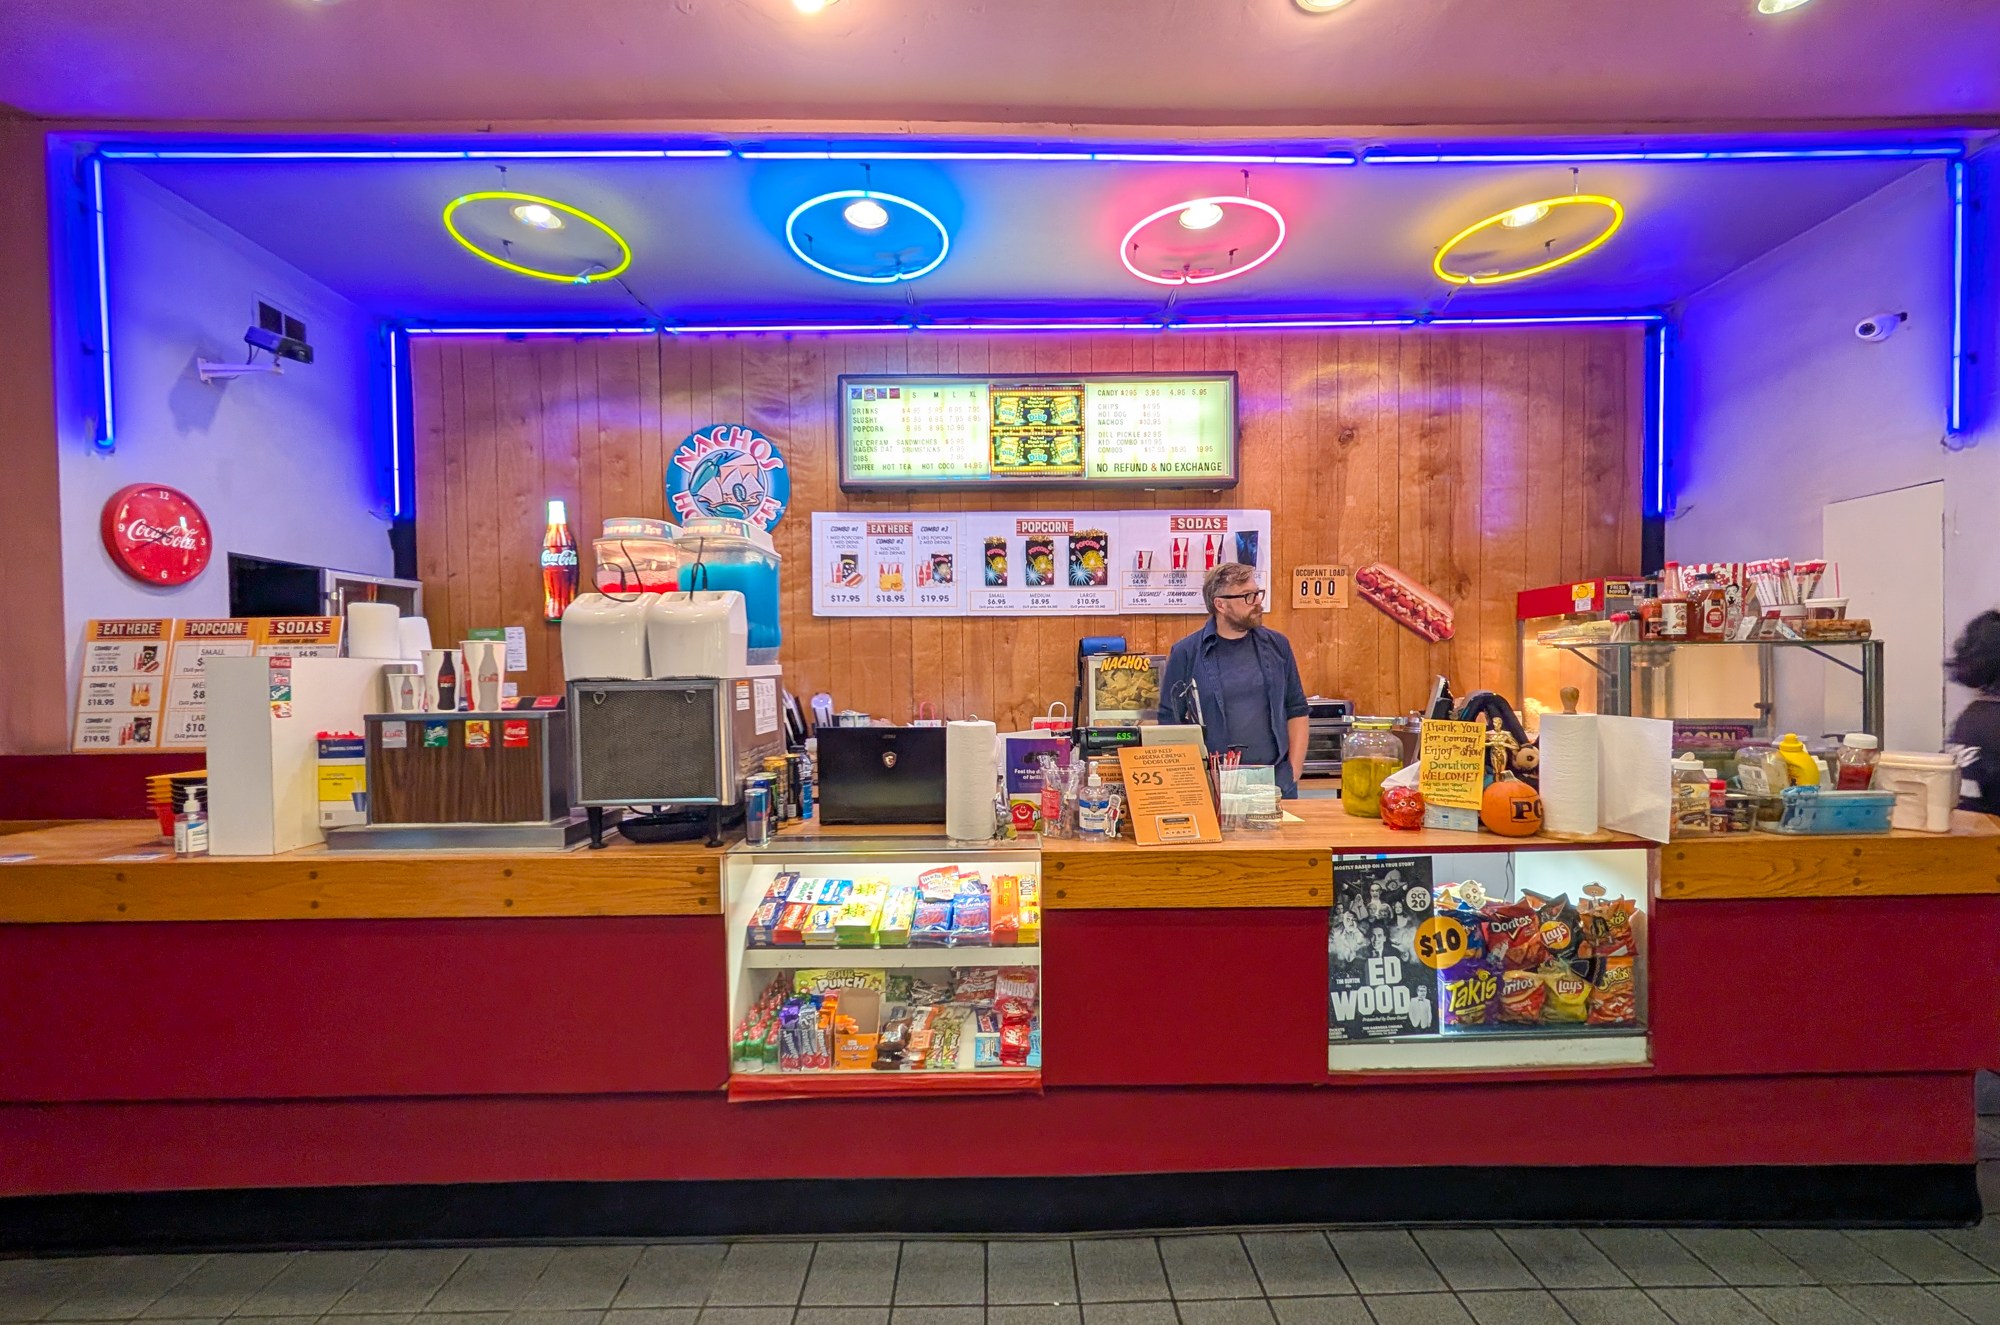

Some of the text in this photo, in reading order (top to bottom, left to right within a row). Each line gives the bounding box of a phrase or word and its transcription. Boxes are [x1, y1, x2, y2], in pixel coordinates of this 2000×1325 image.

[674, 426, 784, 474] NACHOS
[1096, 462, 1222, 472] NO REFUND & NO EXCHANGE
[160, 491, 169, 500] 12
[118, 524, 126, 532] 9
[871, 524, 909, 534] EAT HERE
[1022, 521, 1068, 532] POPCORN
[1178, 518, 1221, 529] SODAS
[127, 518, 199, 550] Coca-Cola
[1028, 546, 1050, 555] POPCORN
[1076, 540, 1100, 550] POPCORN
[541, 550, 578, 566] Coca-Cola
[161, 570, 168, 579] 6
[1296, 568, 1346, 576] OCCUPANT LOAD
[830, 594, 860, 602] $17.95
[876, 594, 905, 602] $18.95
[920, 594, 950, 602] $19.95
[103, 624, 156, 635] EAT HERE
[190, 622, 243, 635] POPCORN
[277, 622, 324, 634] SODAS
[1100, 655, 1150, 672] NACHOS
[186, 724, 206, 732] $10.
[1423, 722, 1479, 734] Thank You
[1424, 733, 1481, 748] for coming!
[1424, 746, 1452, 760] Enjoy
[1460, 744, 1484, 758] show!
[1430, 760, 1480, 770] Donations
[1132, 771, 1164, 786] $25
[1422, 770, 1480, 782] WELCOME!
[1411, 900, 1426, 908] 20
[1490, 915, 1532, 932] Doritos
[1419, 927, 1462, 958] $10
[826, 970, 854, 979] SOUR
[1367, 955, 1402, 986] ED
[816, 978, 866, 992] PUNCH
[1446, 976, 1498, 1012] Takis
[1330, 984, 1411, 1022] WOOD
